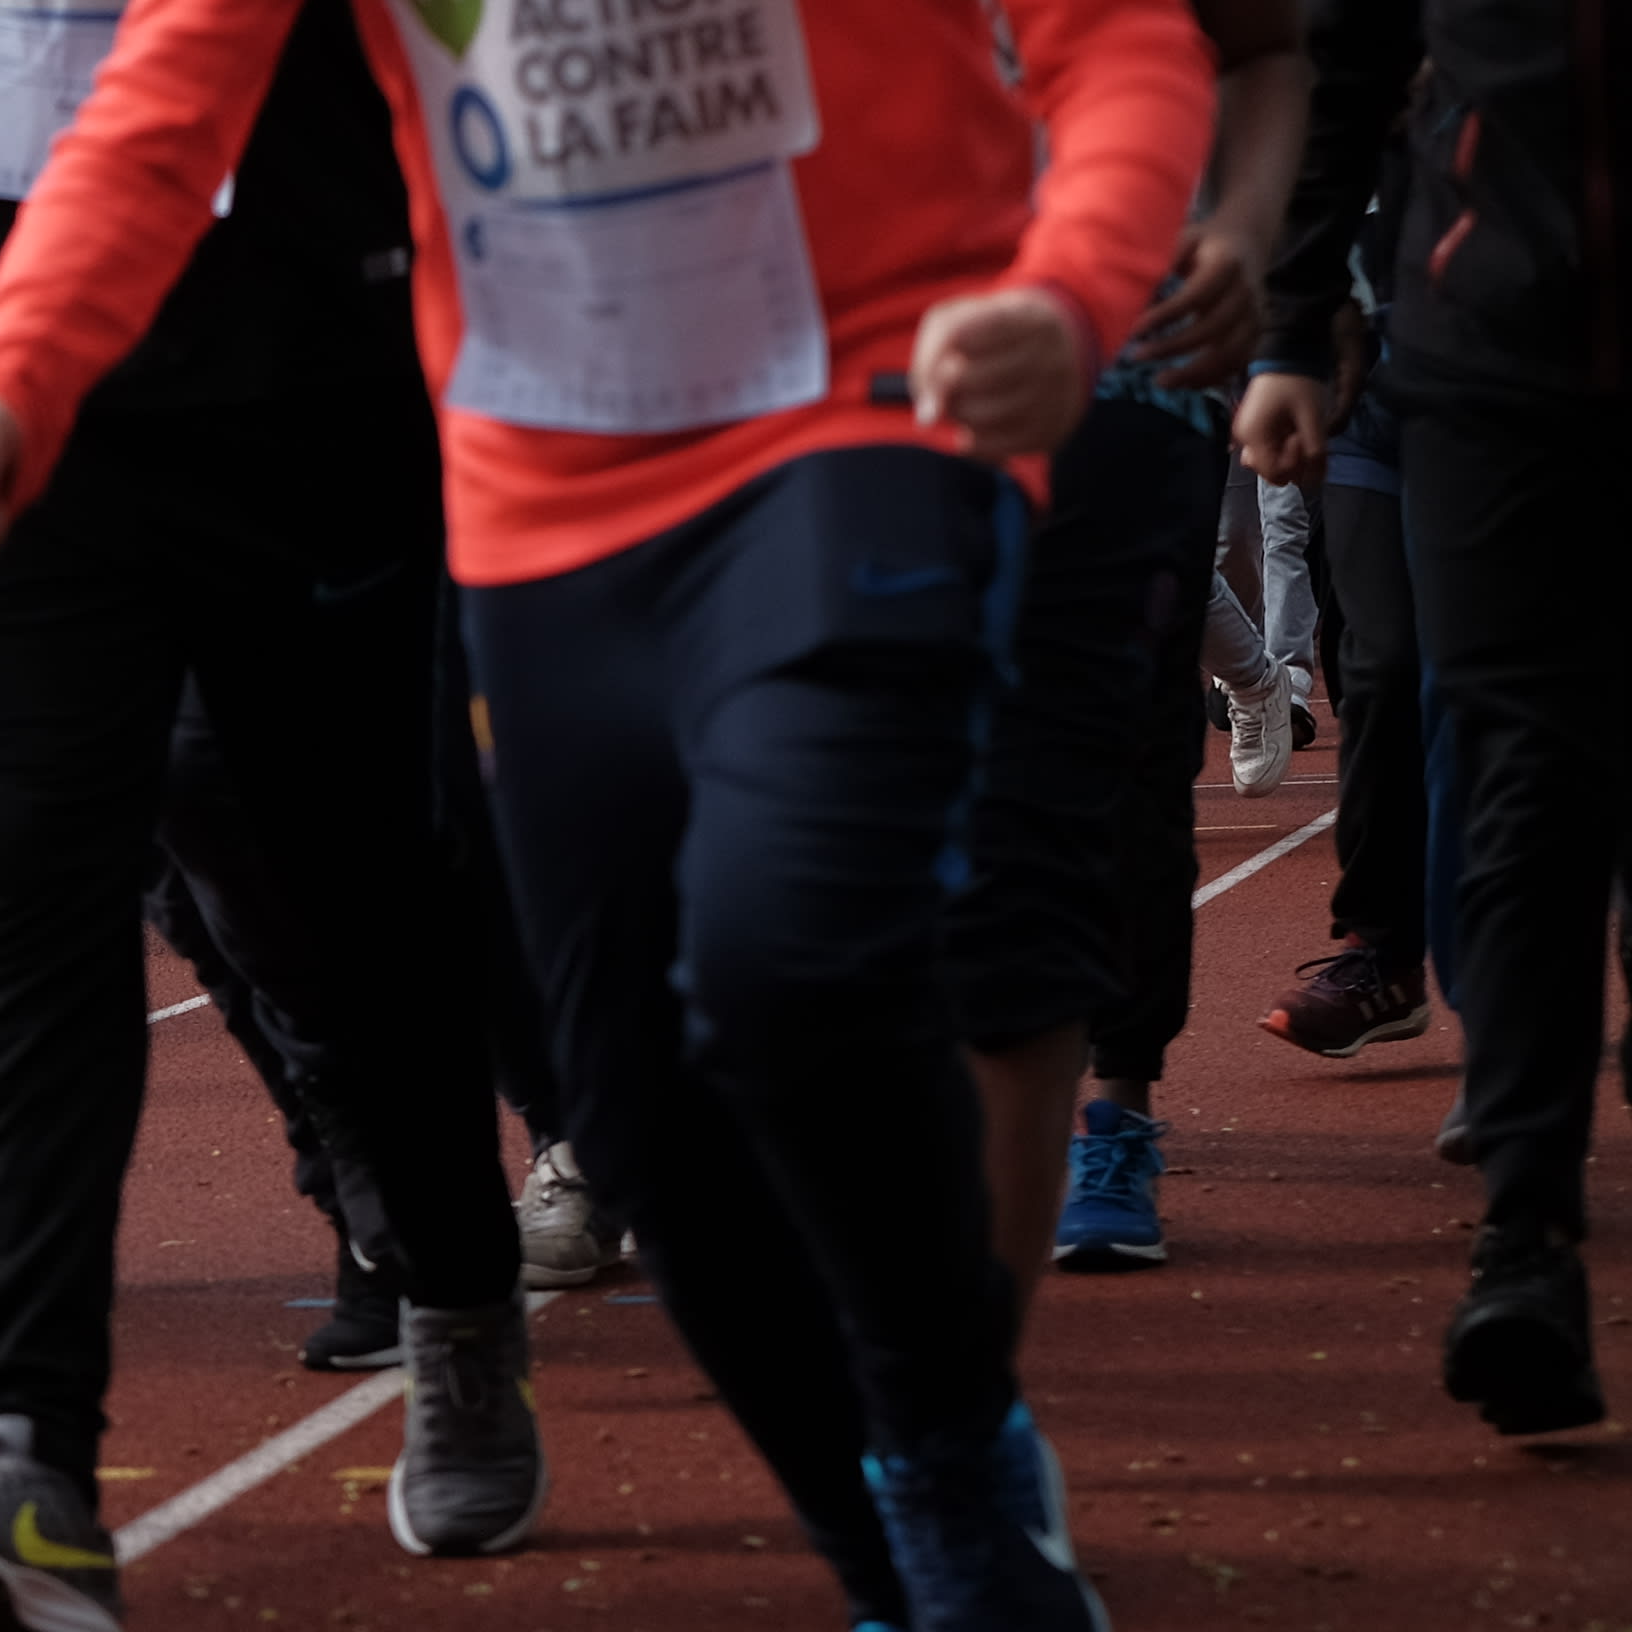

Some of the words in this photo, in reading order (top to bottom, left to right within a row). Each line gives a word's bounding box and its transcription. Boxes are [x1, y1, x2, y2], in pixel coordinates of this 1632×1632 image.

[517, 8, 770, 104] CONTRE
[524, 108, 603, 166] LA
[612, 74, 782, 153] FAIM
